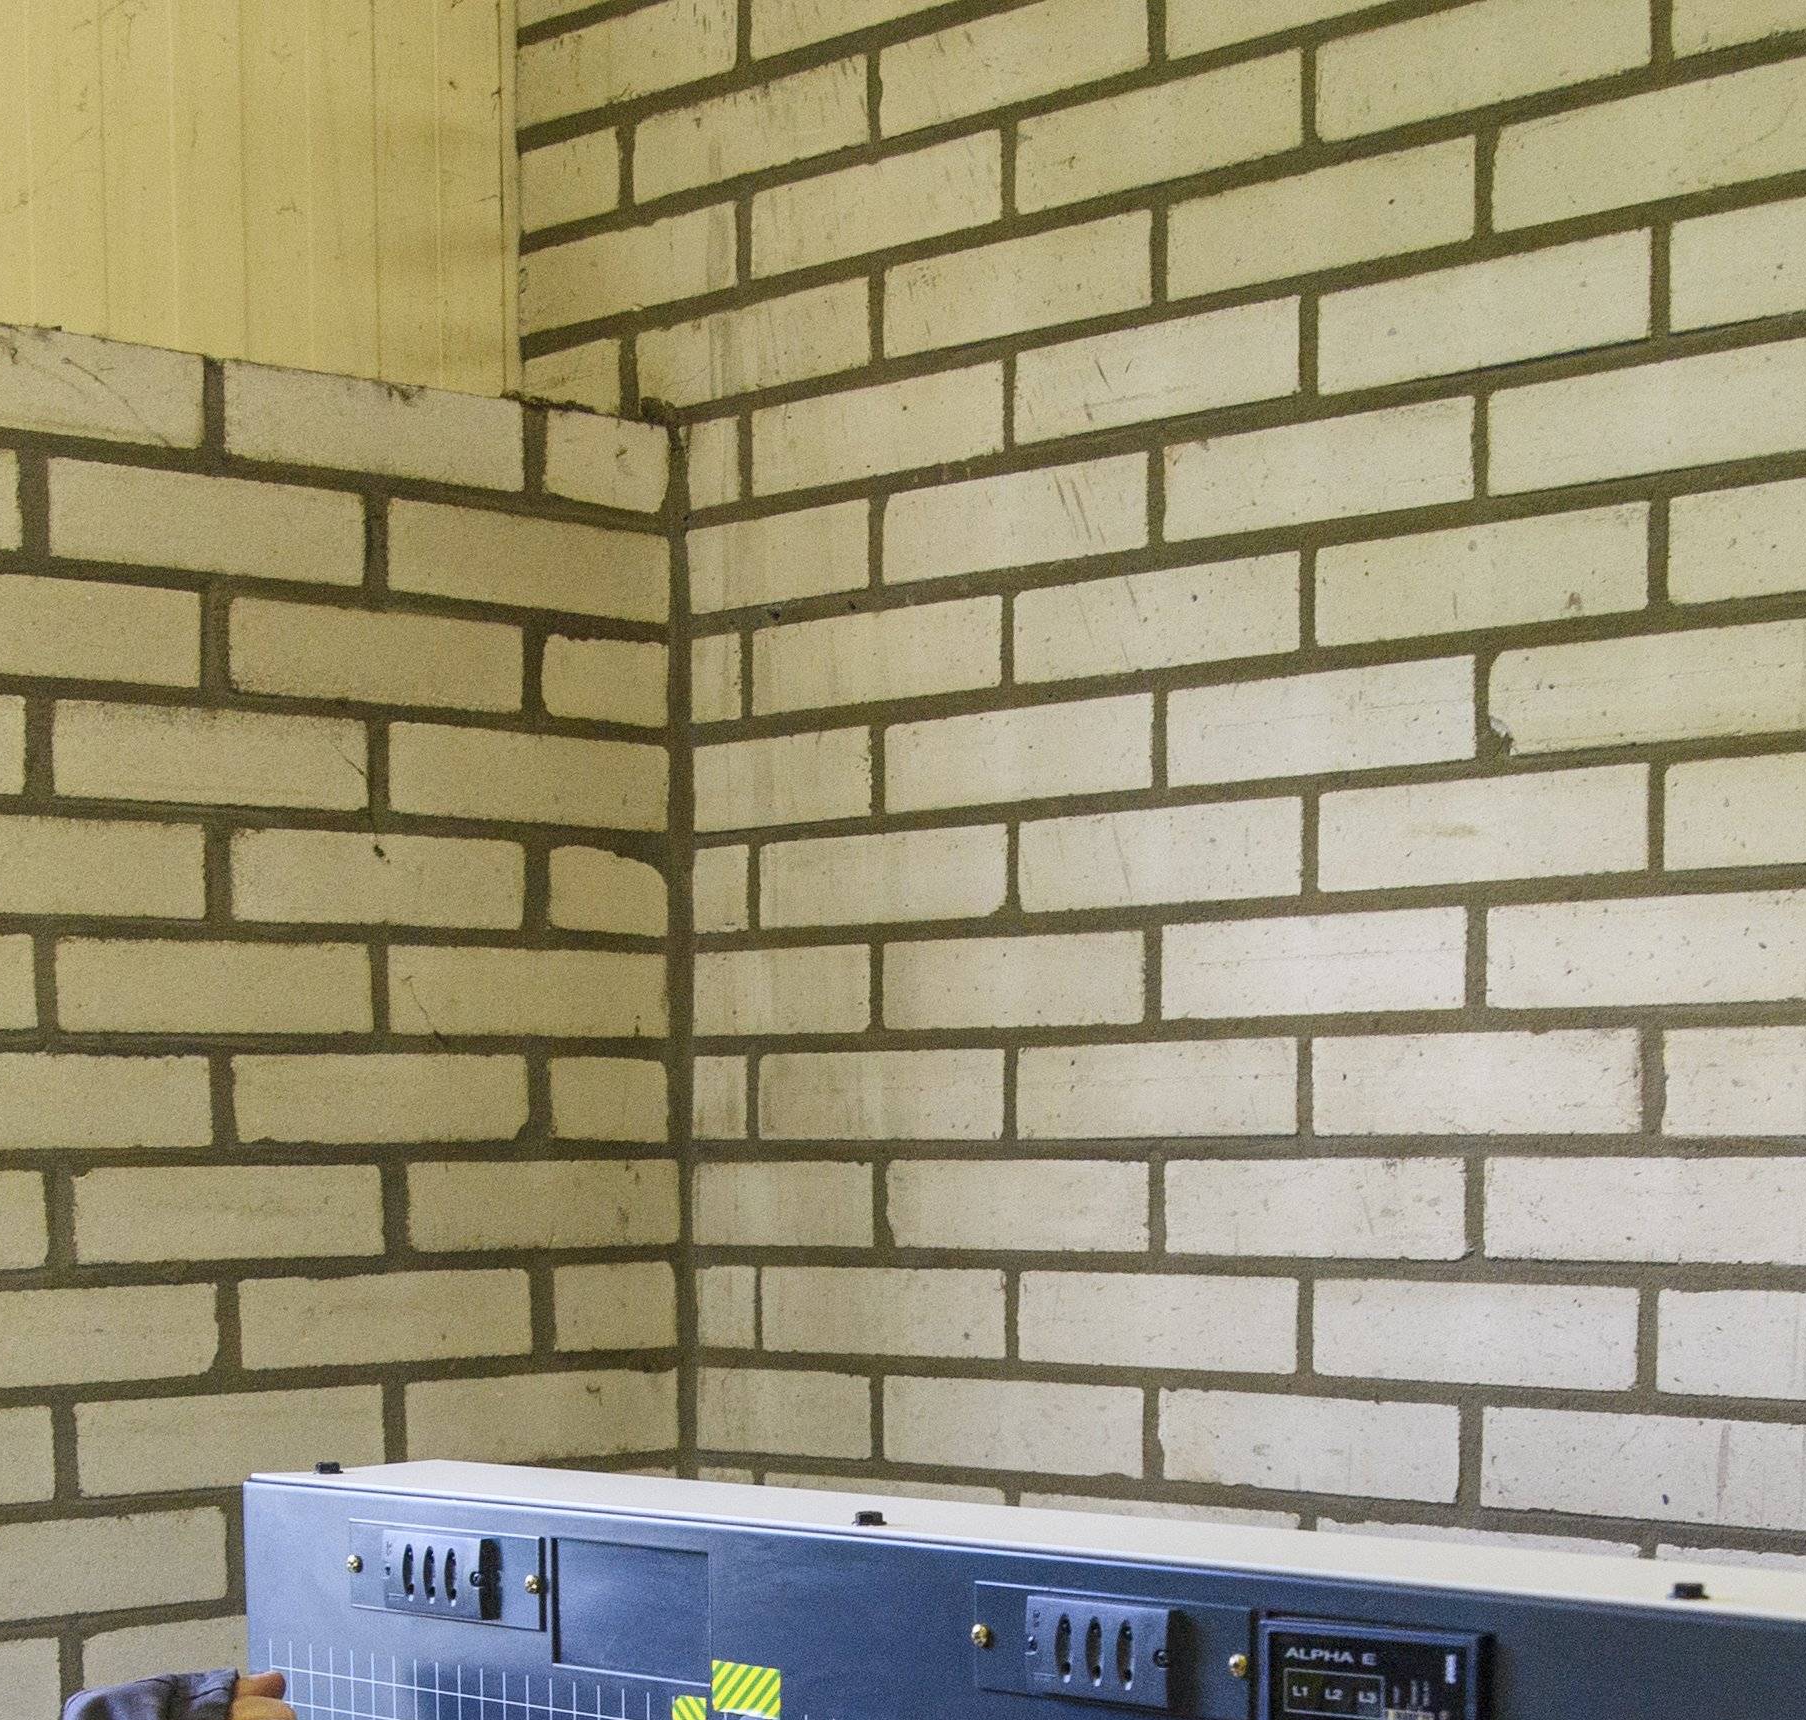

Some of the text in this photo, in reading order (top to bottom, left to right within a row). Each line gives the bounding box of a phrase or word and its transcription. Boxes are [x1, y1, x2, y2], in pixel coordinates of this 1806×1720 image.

[1284, 1646, 1377, 1667] ALPHA E
[1291, 1685, 1376, 1704] L1 L2 L3
